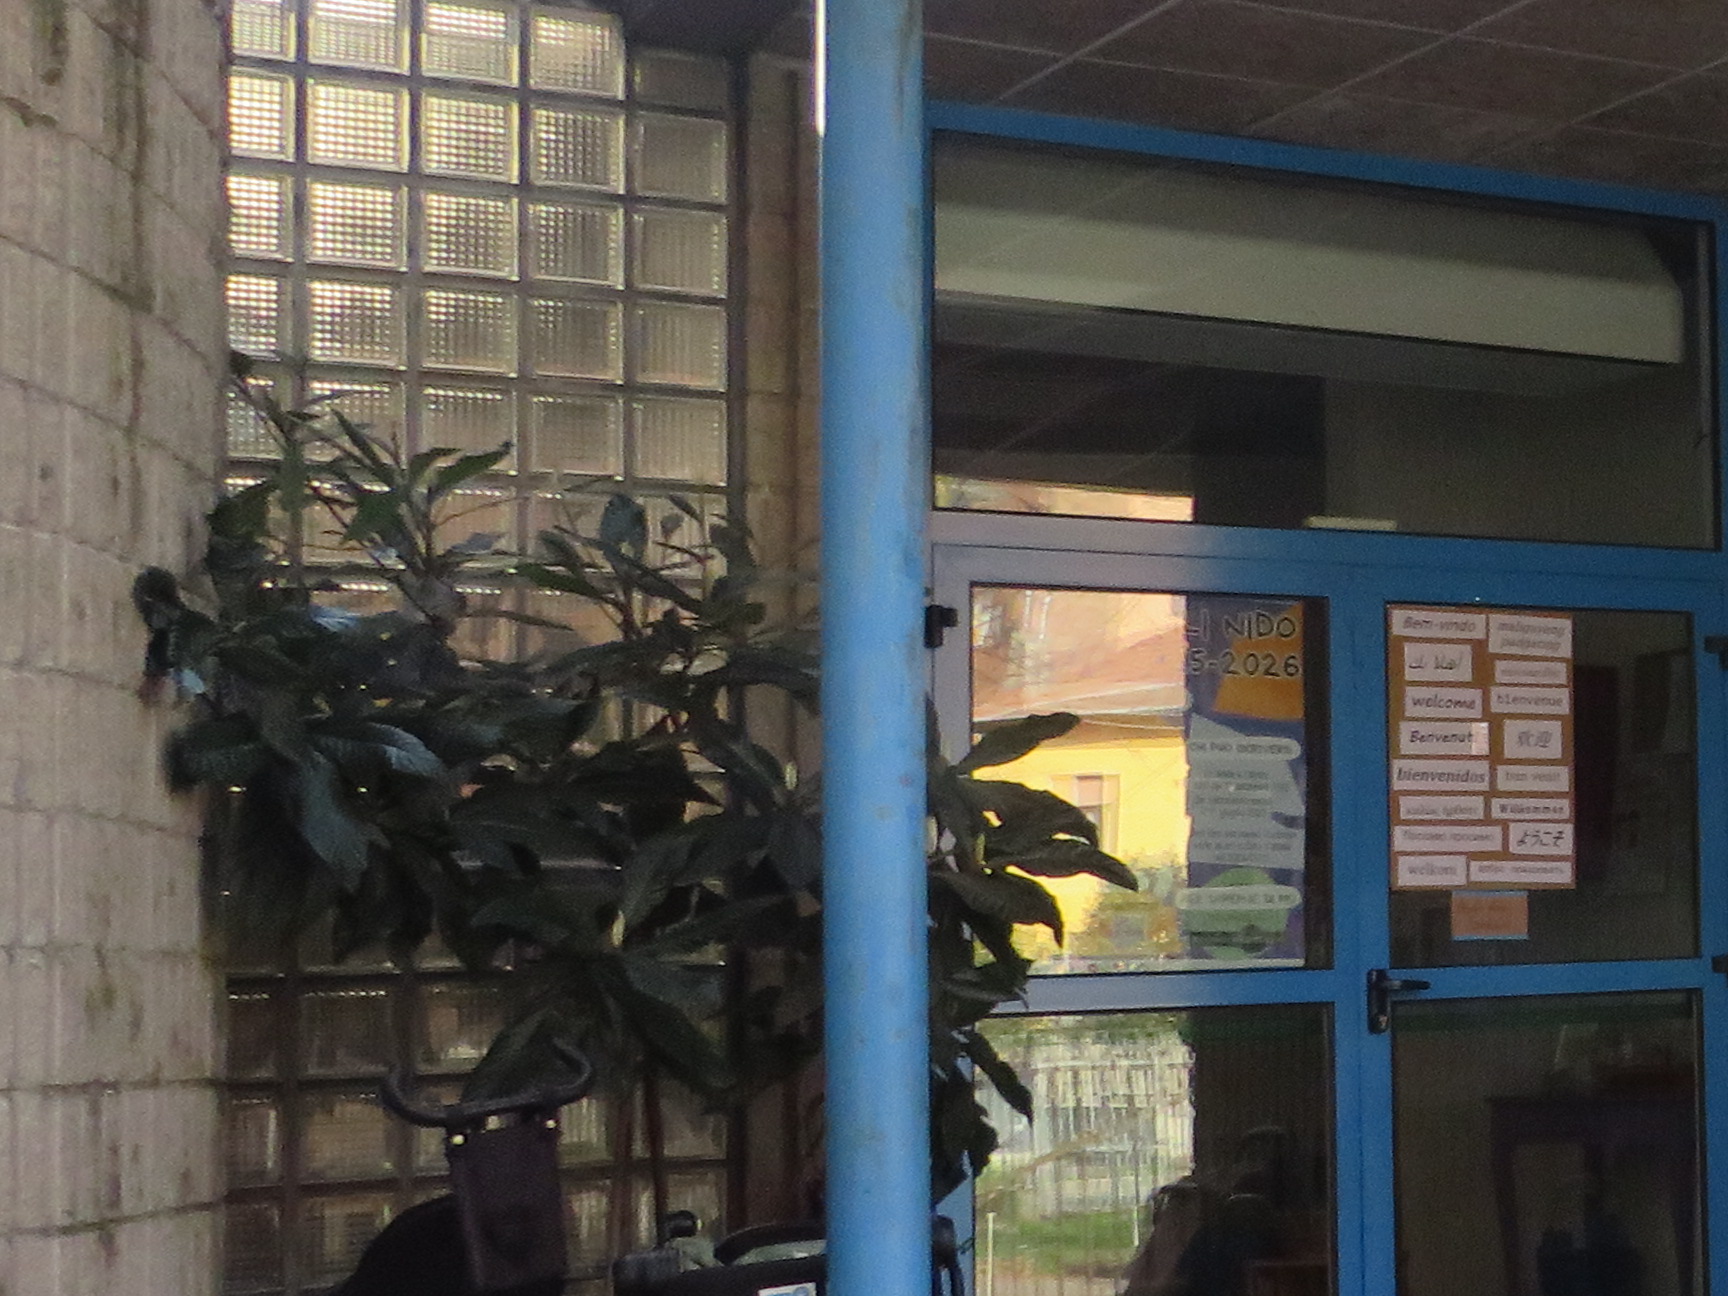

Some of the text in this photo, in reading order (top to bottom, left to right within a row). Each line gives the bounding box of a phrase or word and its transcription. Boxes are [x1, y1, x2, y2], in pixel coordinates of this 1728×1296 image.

[1223, 609, 1297, 641] NIDO
[1411, 693, 1476, 710] welcome
[1395, 766, 1486, 784] bienvenidos
[1516, 830, 1566, 848] ようこそ
